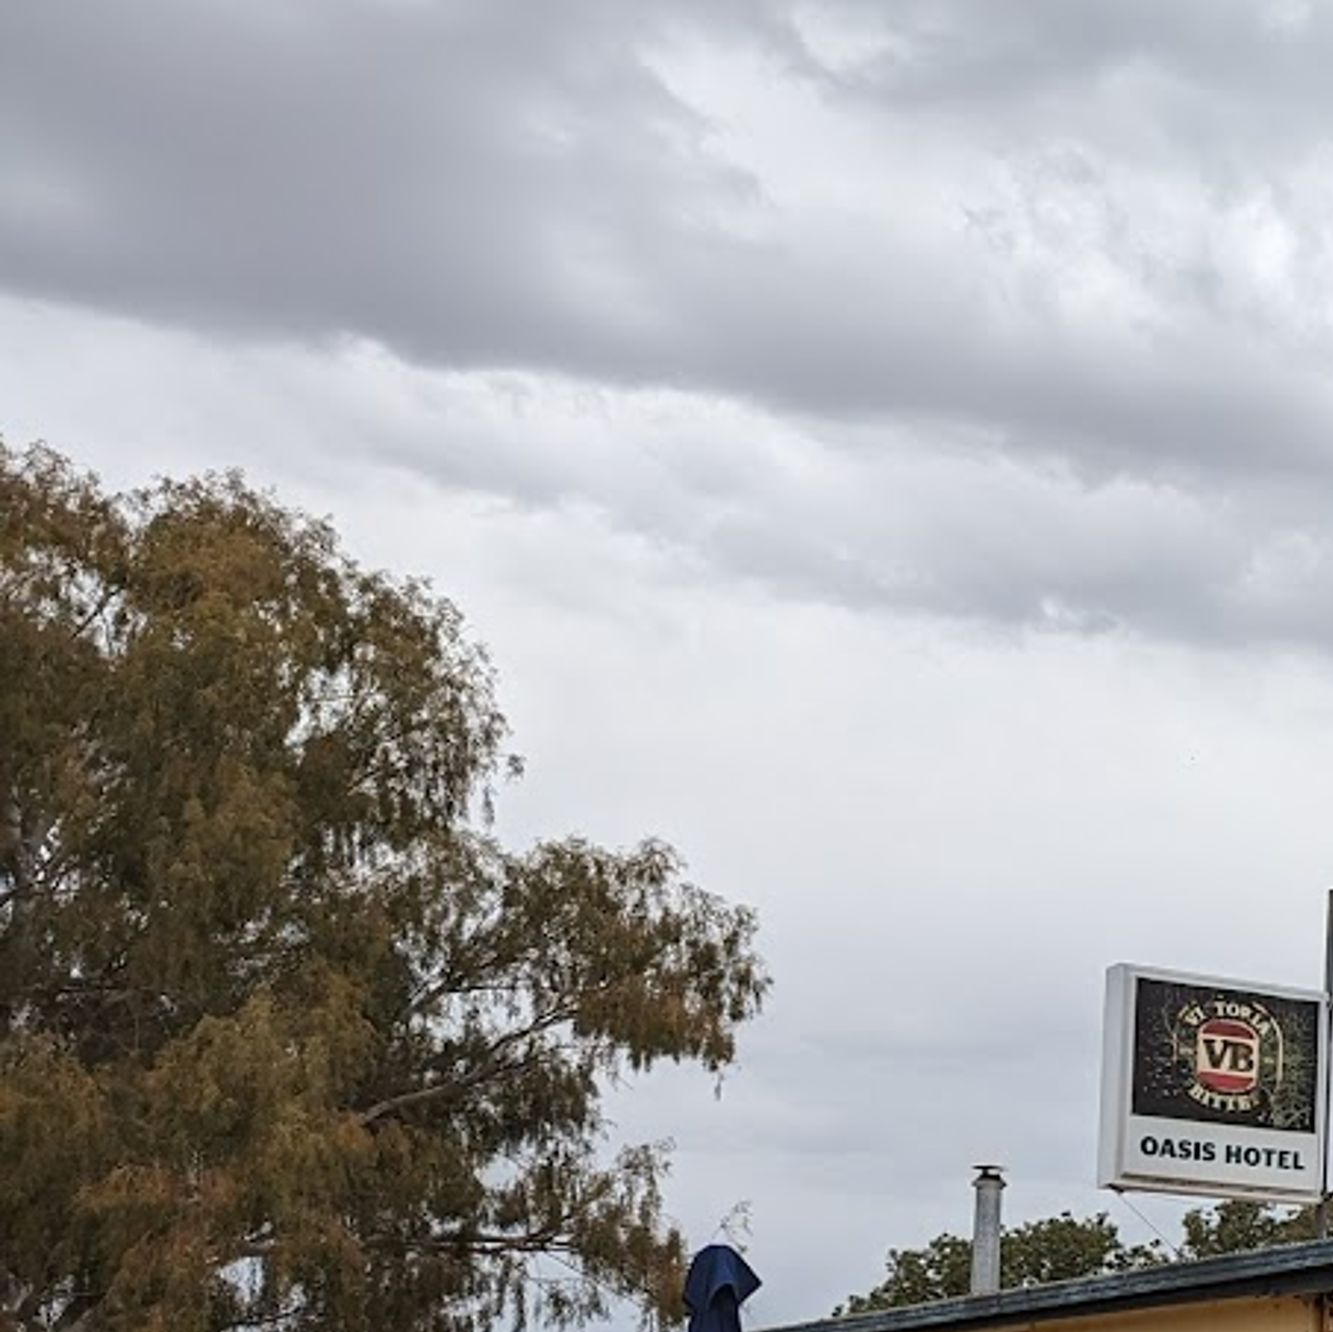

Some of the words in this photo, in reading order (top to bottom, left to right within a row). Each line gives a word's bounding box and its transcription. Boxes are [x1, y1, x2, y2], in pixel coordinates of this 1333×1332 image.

[1184, 1000, 1271, 1035] VITORIA
[1203, 1039, 1255, 1072] VB
[1140, 1136, 1216, 1161] OASIS
[1225, 1145, 1306, 1170] HOTEL
